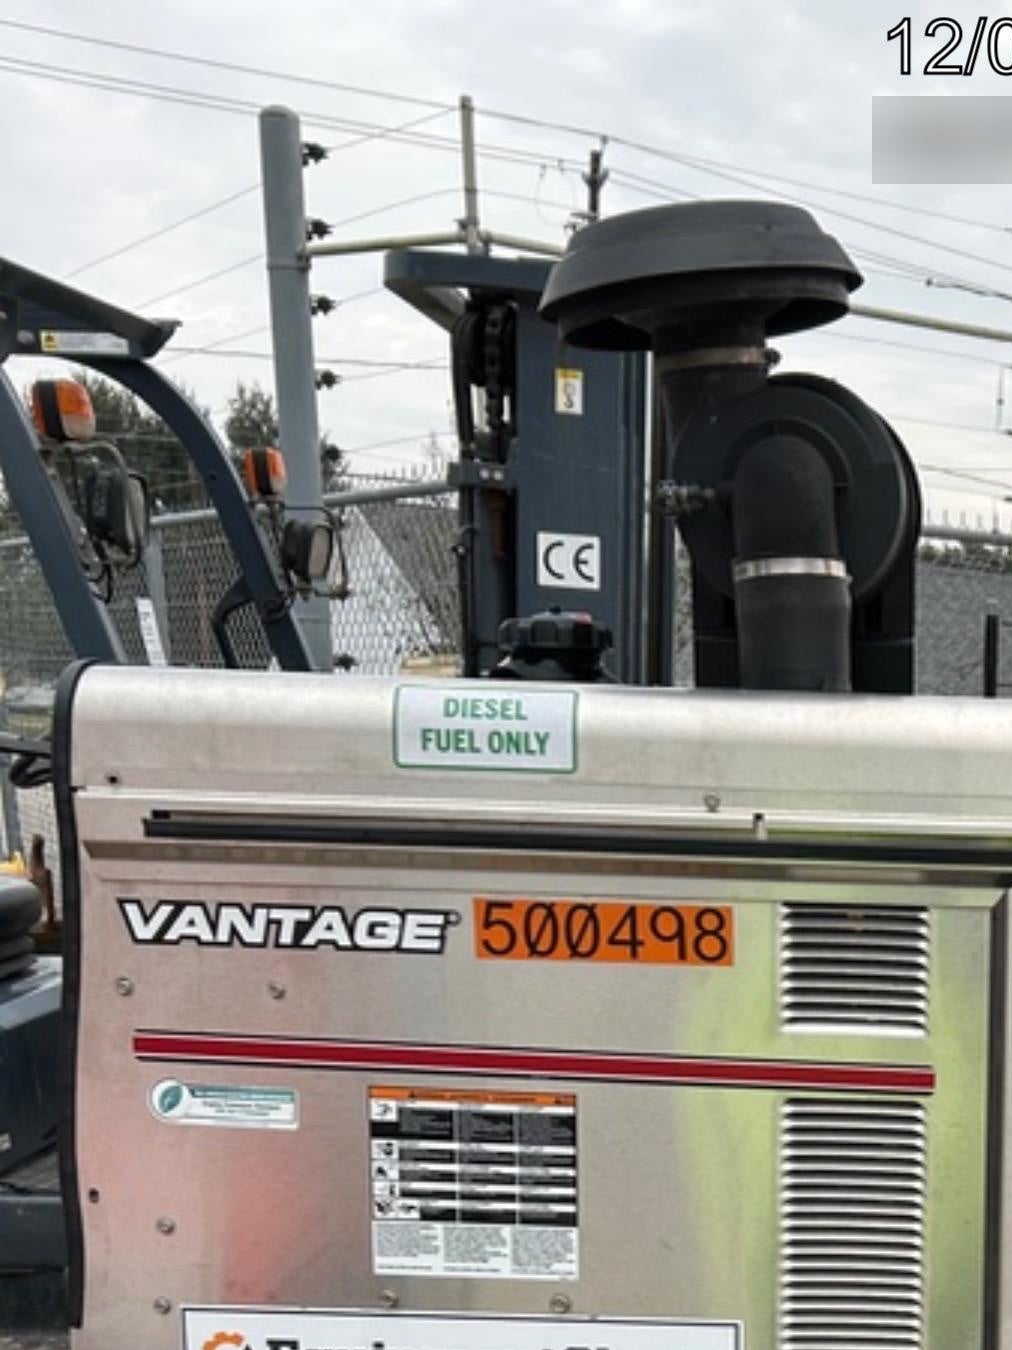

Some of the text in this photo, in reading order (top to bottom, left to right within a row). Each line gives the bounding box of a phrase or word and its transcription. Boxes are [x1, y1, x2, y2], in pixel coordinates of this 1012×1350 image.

[442, 696, 528, 722] DIESEL
[420, 728, 551, 757] FUEL ONLY
[119, 900, 452, 952] VANTAGE
